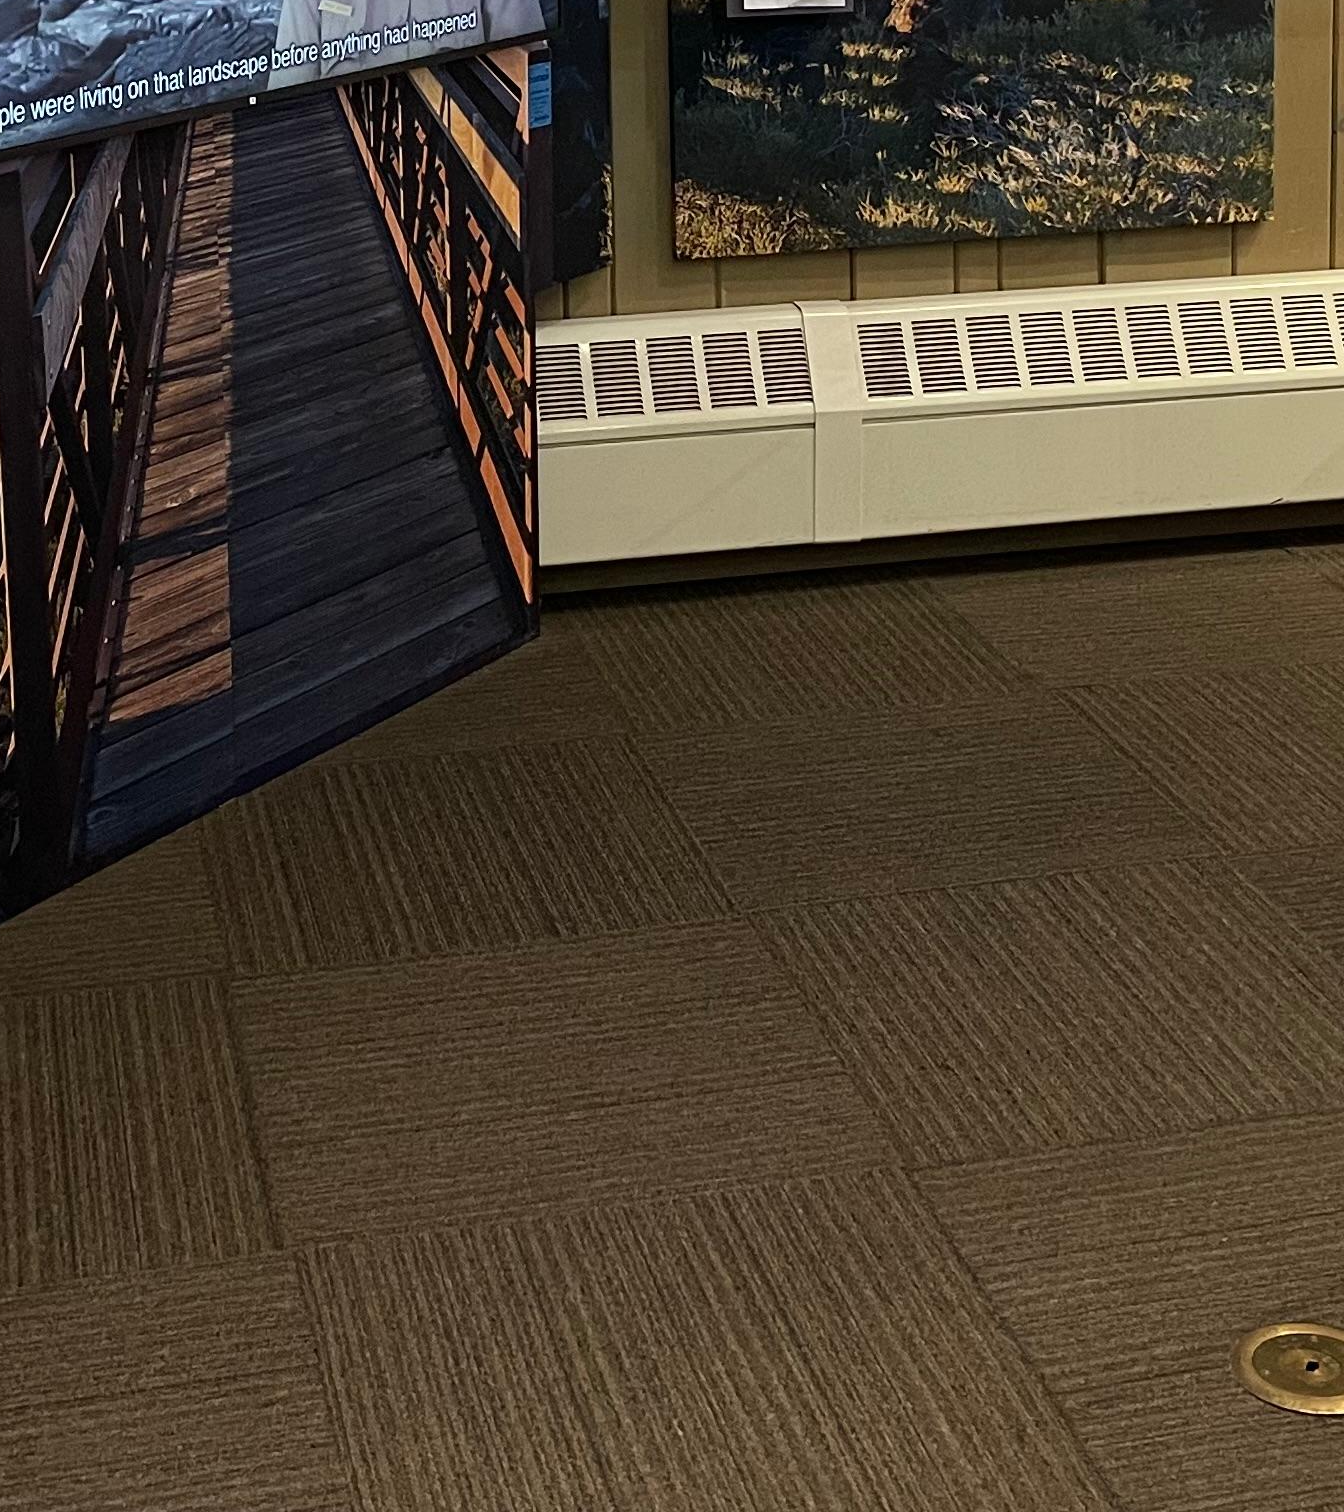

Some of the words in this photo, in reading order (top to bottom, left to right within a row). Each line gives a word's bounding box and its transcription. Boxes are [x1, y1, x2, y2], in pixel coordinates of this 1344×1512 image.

[30, 93, 75, 120] were
[79, 84, 123, 109] living
[127, 78, 149, 100] on
[153, 69, 185, 94] that
[188, 54, 268, 87] landscape
[271, 45, 318, 69] before
[322, 31, 380, 60] anything
[384, 24, 409, 45] had
[413, 10, 477, 40] happened
